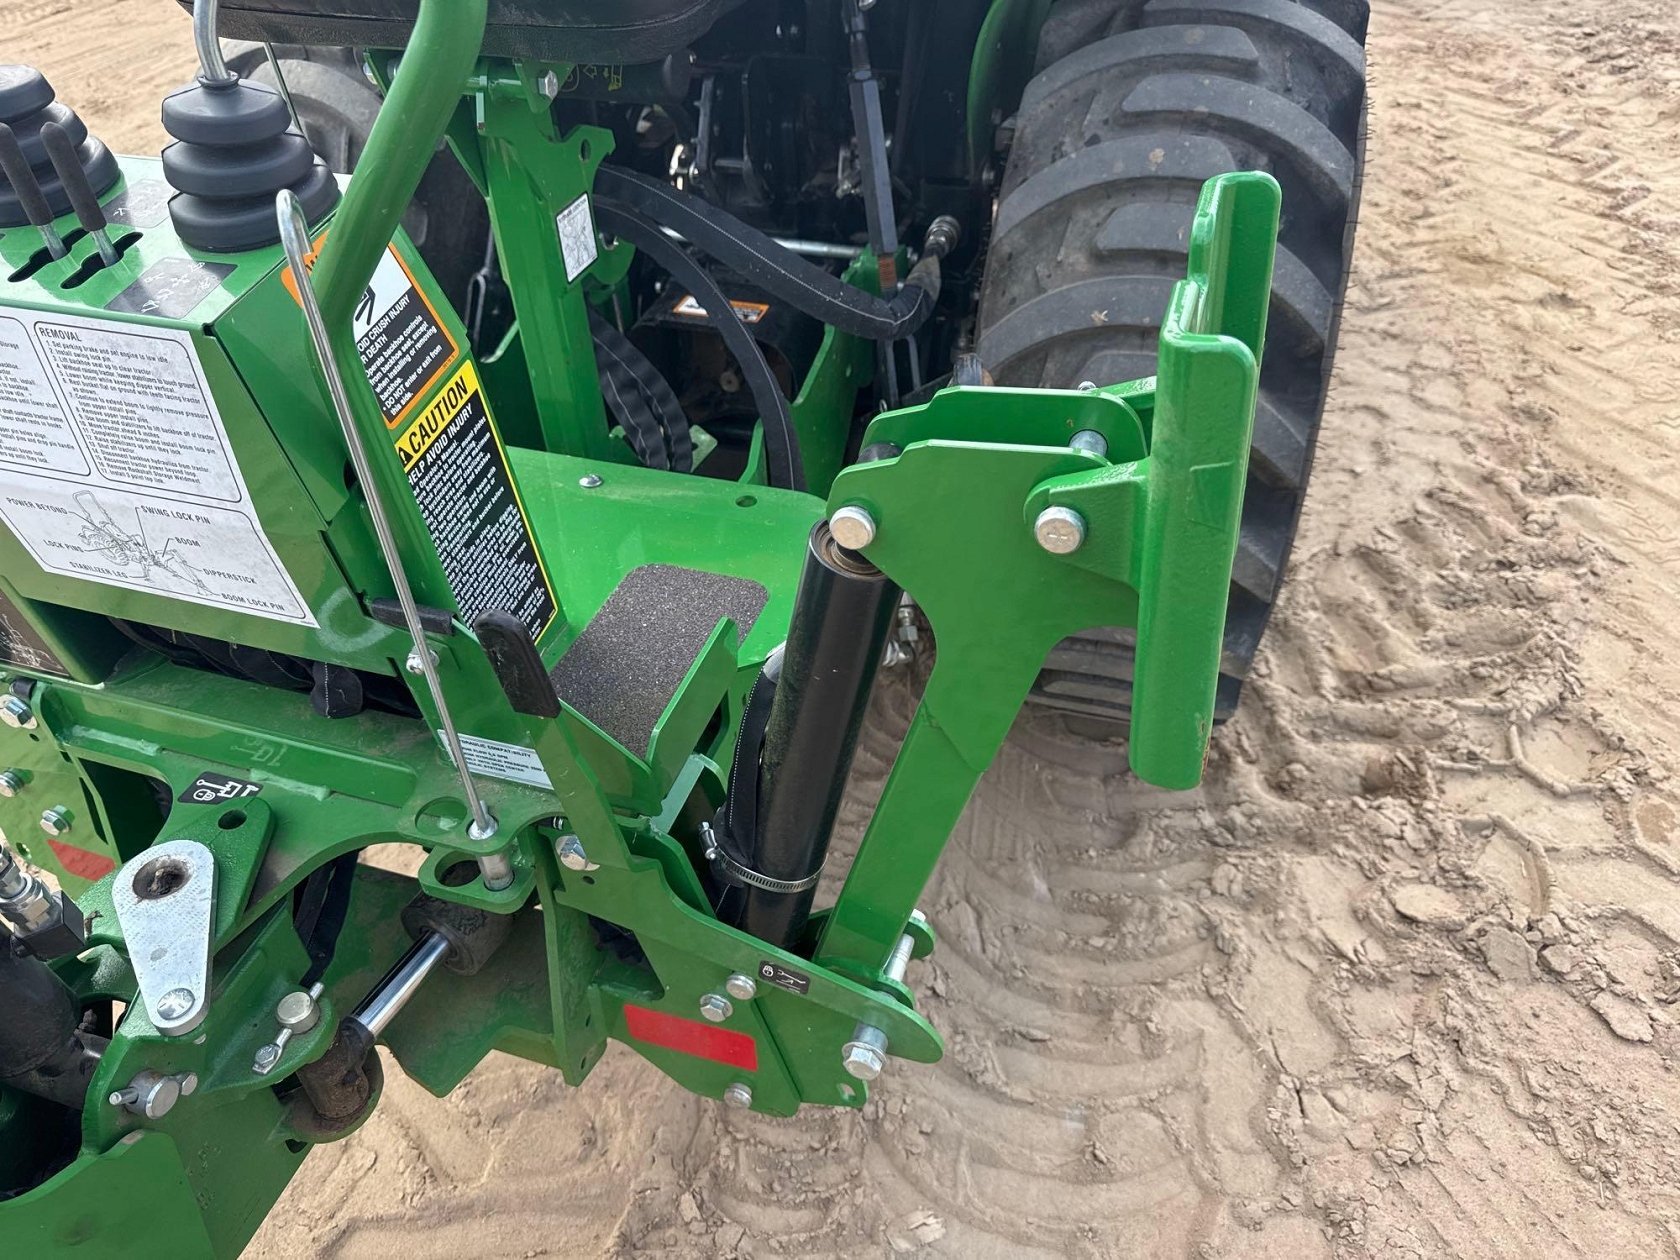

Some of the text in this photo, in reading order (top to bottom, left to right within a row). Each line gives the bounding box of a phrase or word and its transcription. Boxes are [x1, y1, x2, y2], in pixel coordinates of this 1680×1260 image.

[38, 327, 81, 341] REMOVAL
[356, 294, 409, 351] OID CRUSH INJURY
[360, 333, 387, 363] R DEATH
[380, 350, 402, 373] backhoe
[401, 338, 414, 352] seat,
[412, 320, 428, 339] except
[382, 334, 404, 357] backhoe
[403, 315, 422, 336] controls
[374, 325, 436, 392] when installing or removing
[384, 344, 442, 408] DO NOT enter or exit from
[408, 375, 469, 454] CAUTION
[426, 432, 449, 466] AVOID
[448, 402, 473, 437] INJURY
[6, 497, 68, 516] POWER BEYOND
[140, 504, 212, 525] SWING LOCK PIN
[43, 540, 84, 553] LOCK PINS
[174, 536, 201, 548] BOOM
[70, 562, 128, 579] STABILIZER LEG
[203, 568, 258, 585] DIPPERSTICK
[221, 593, 286, 612] BOOM LOCK PIN
